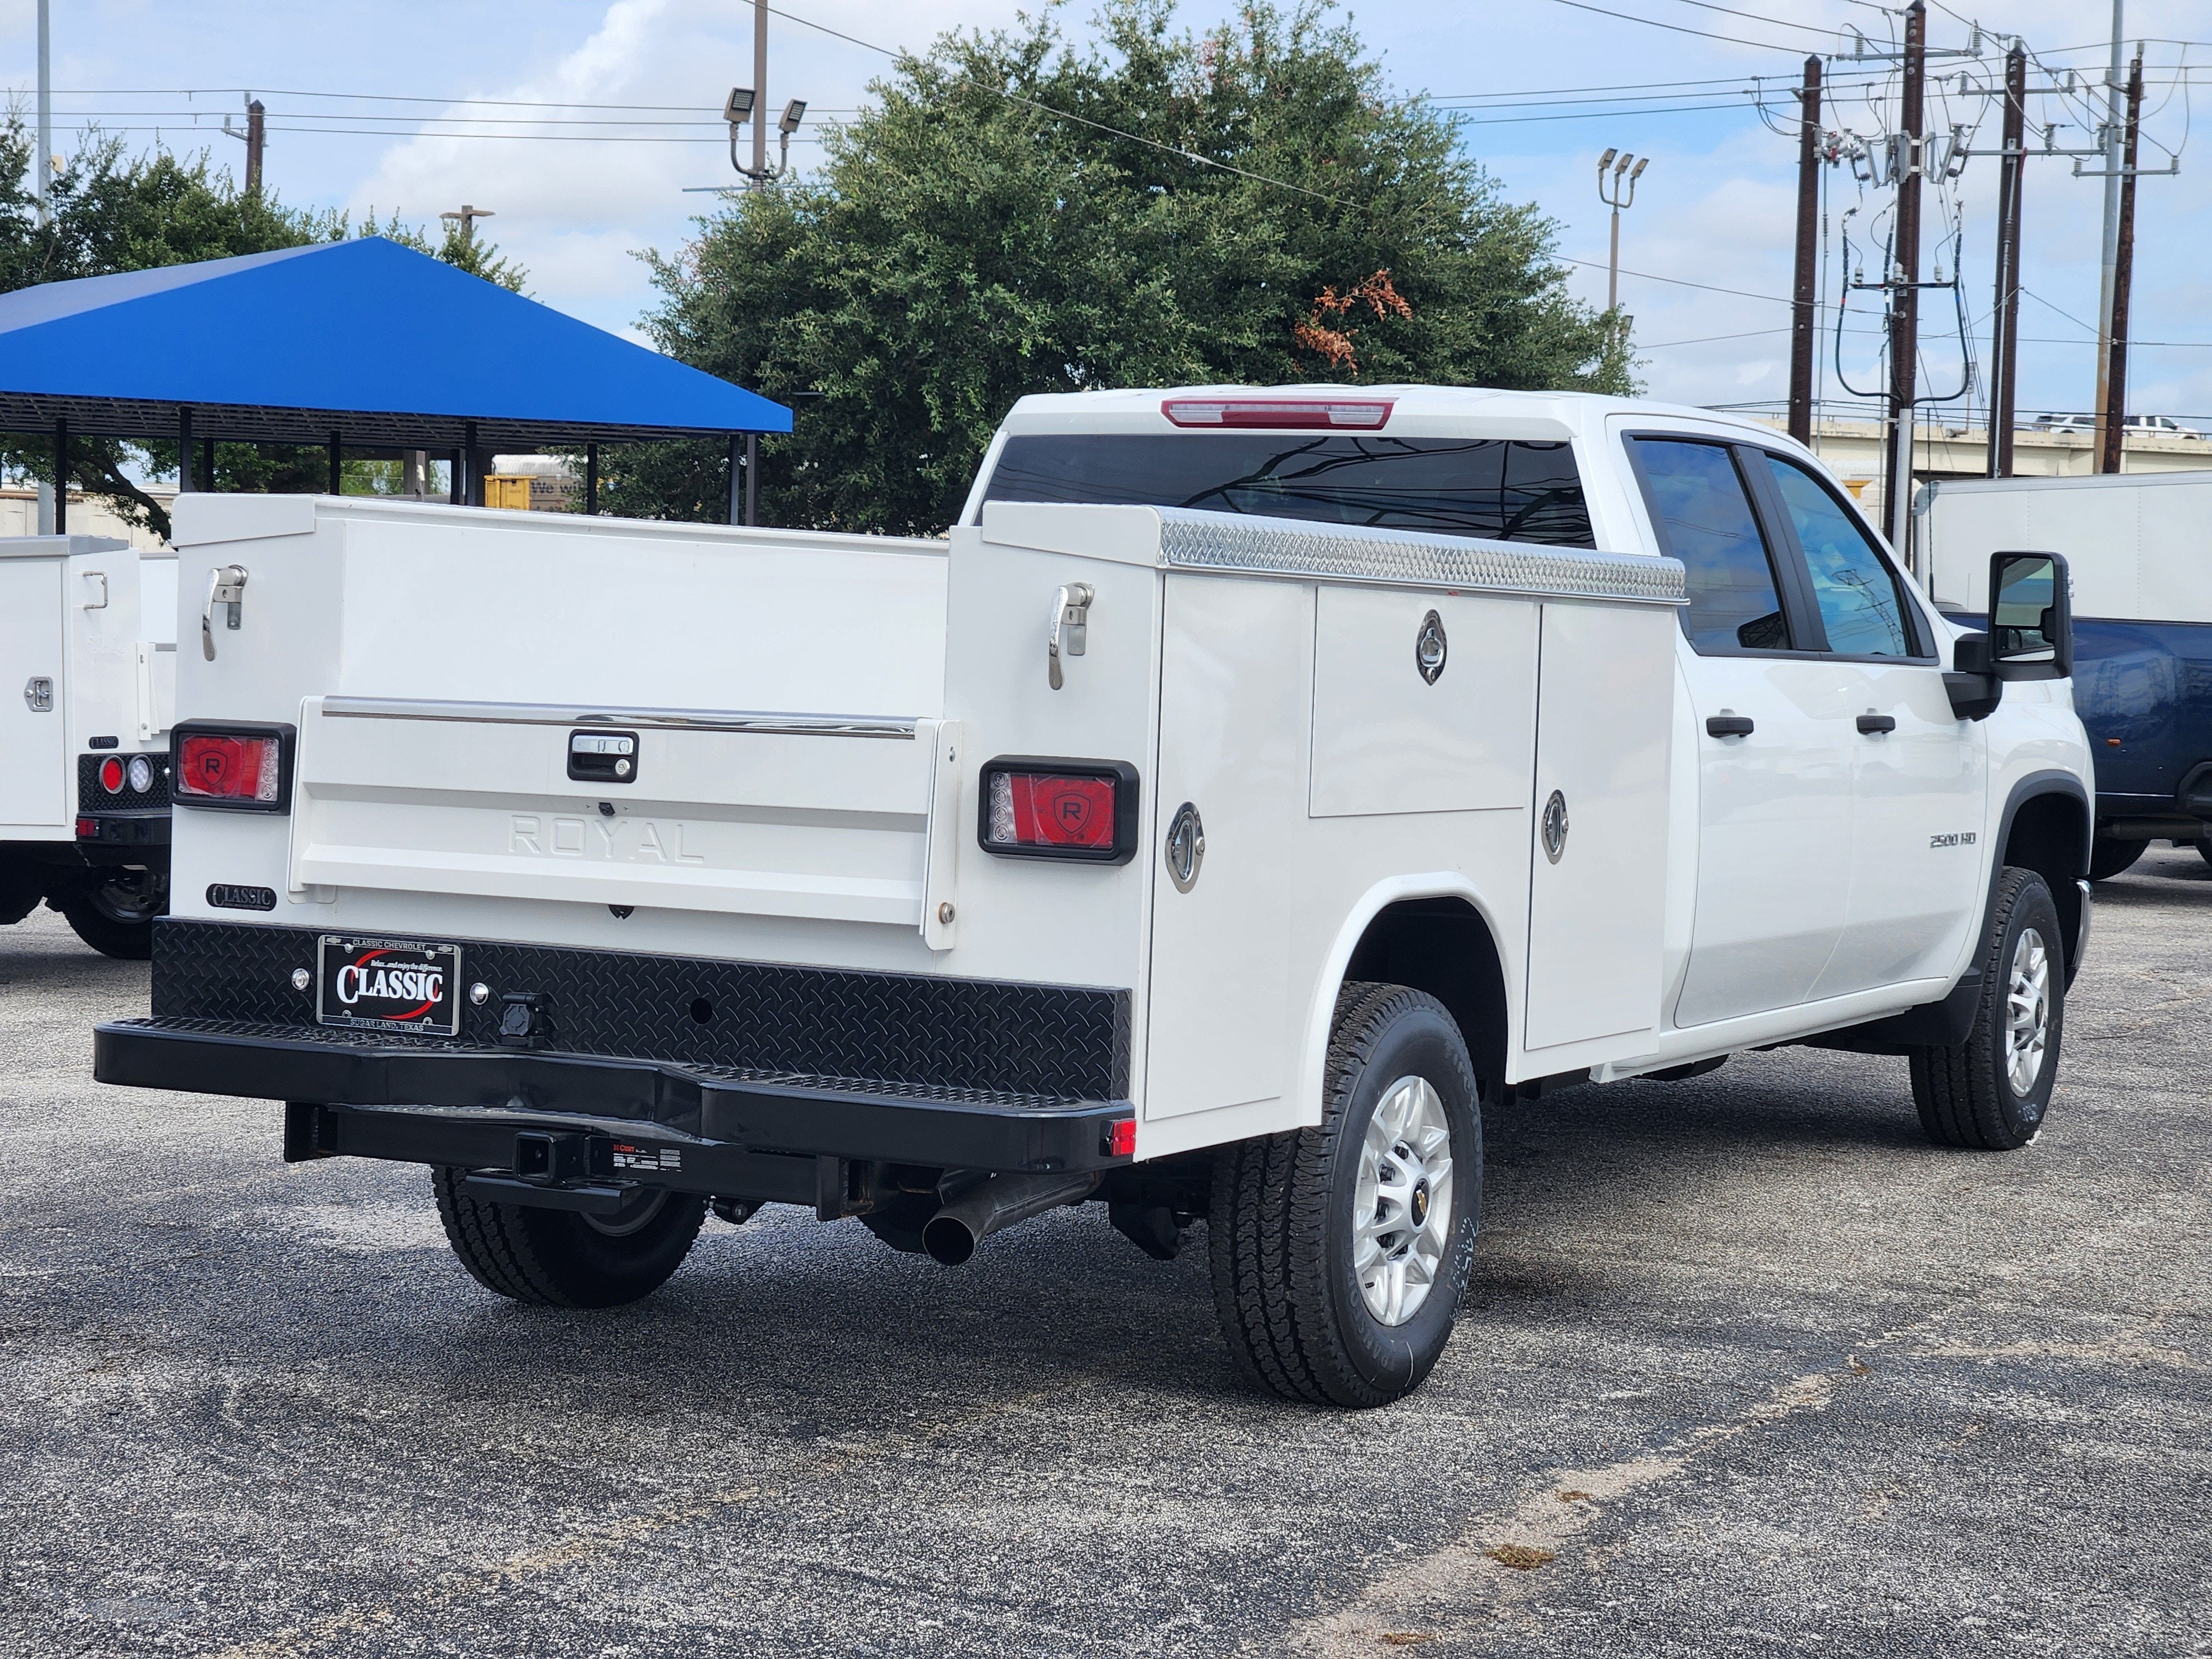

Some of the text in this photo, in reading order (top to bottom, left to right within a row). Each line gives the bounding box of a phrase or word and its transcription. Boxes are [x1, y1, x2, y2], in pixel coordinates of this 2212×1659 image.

[205, 758, 220, 774] R
[1063, 802, 1081, 820] R
[508, 815, 705, 864] ROYAL
[1930, 832, 1976, 848] 2500 HD
[212, 885, 271, 906] CLASSIC
[353, 939, 426, 951] CLASSIC CHEVROLET
[337, 965, 443, 1004] CLASSIC
[349, 1019, 375, 1027] SUGAR
[399, 1023, 424, 1032] TEXAS
